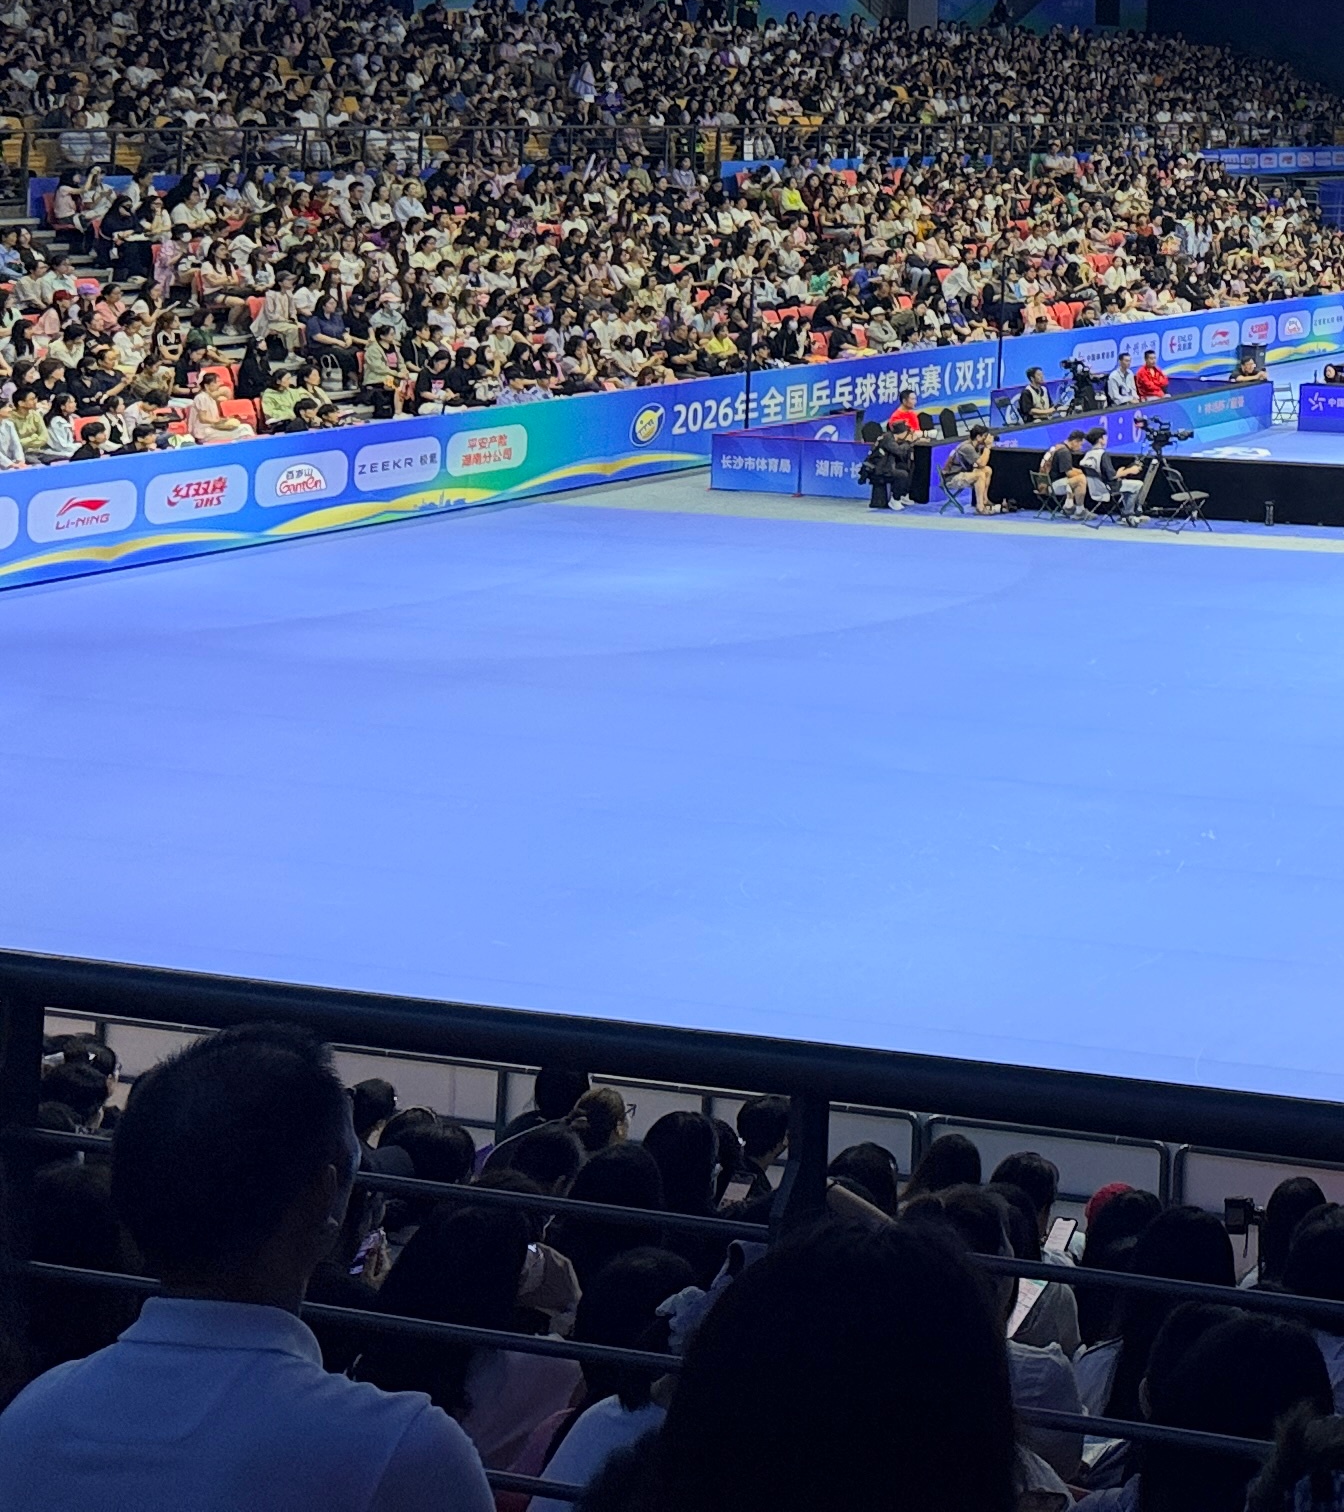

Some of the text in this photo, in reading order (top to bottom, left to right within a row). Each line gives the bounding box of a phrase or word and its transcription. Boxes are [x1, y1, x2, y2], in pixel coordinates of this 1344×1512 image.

[358, 457, 413, 475] ZEEKR
[461, 448, 512, 468] 湖南分公司
[721, 454, 791, 473] 长沙市体育局
[55, 513, 111, 530] LI-NING
